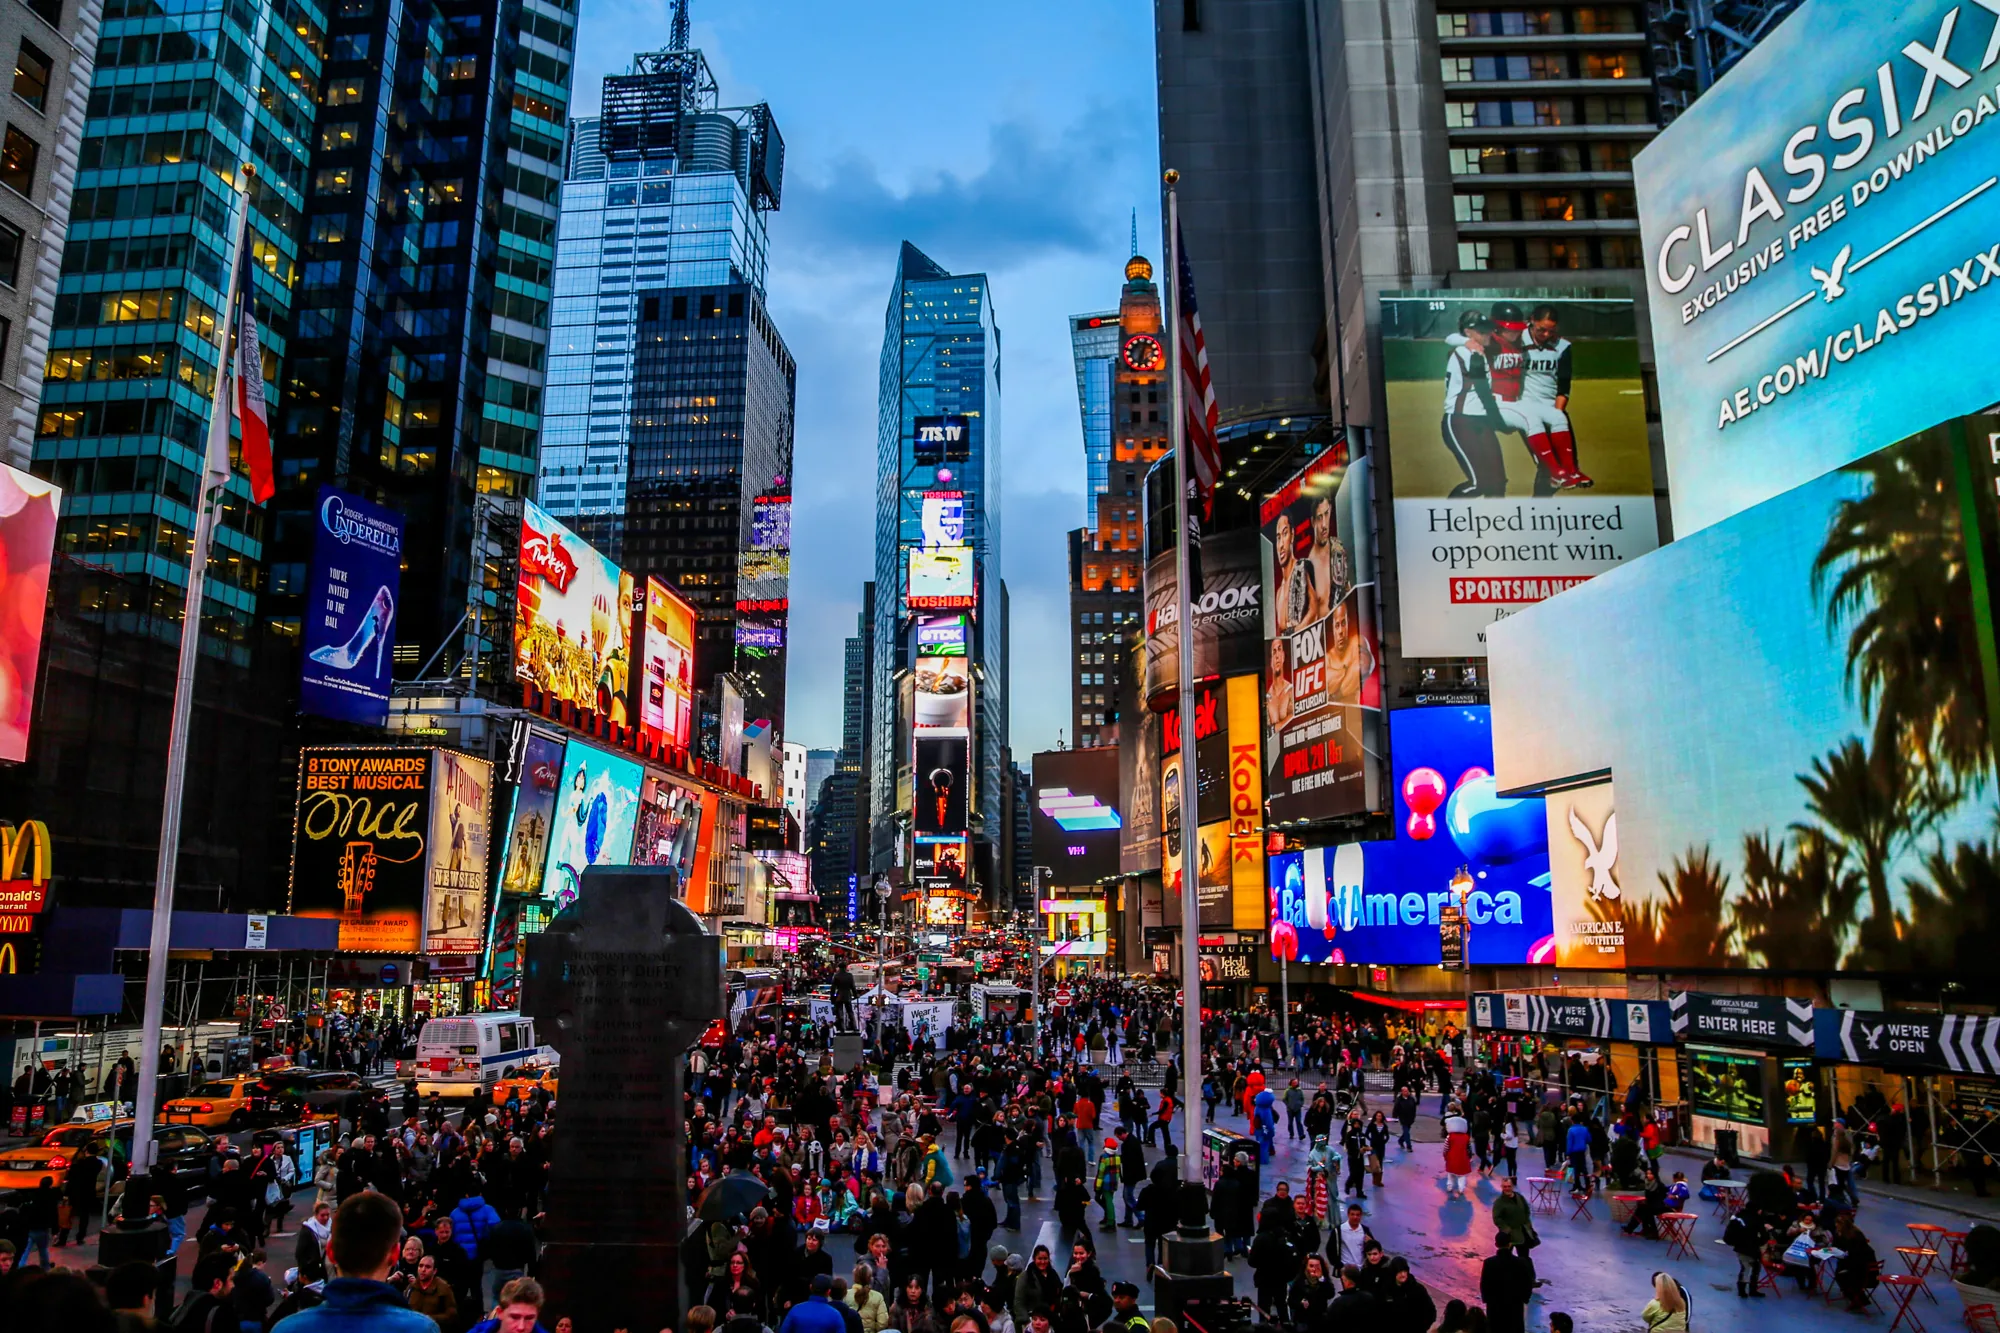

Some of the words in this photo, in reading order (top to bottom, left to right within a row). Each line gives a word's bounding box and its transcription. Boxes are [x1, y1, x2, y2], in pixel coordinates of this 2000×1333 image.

[1682, 239, 1784, 326] EXCLUSIVE
[1789, 194, 1846, 252] FREE
[1429, 301, 1446, 311] 215
[1493, 353, 1520, 370] WEST
[923, 491, 963, 499] TOSHIBA
[321, 495, 400, 553] CINDERELLA
[1427, 506, 1524, 539] Helped
[1530, 504, 1624, 538] injured
[1431, 542, 1560, 570] opponent
[1562, 536, 1624, 562] win.
[524, 537, 567, 590] Turkey
[329, 566, 348, 583] YOU'RE
[328, 583, 350, 600] INVITED
[326, 598, 334, 612] TO
[335, 600, 345, 615] THE
[631, 603, 644, 612] LG
[911, 596, 972, 608] TOSHIBA
[325, 615, 338, 630] BALL
[1202, 607, 1260, 625] emotion
[931, 629, 962, 641] TDK
[1292, 624, 1325, 669] FOX
[1295, 661, 1324, 698] UFC
[1294, 690, 1327, 715] SATURDAY
[308, 757, 319, 773] 8
[319, 757, 363, 773] TONY
[361, 757, 426, 773] AWARDS
[1283, 747, 1311, 779] APRIL
[1311, 742, 1325, 771] 20
[306, 775, 350, 790] BEST
[353, 775, 425, 790] MUSICAL
[1321, 768, 1335, 787] FOX
[1231, 743, 1260, 864] Kodak
[434, 867, 481, 891] NEWSIES
[353, 926, 380, 934] THEATER
[384, 926, 405, 935] ALBUM
[383, 919, 409, 927] AWARD
[1569, 921, 1614, 934] AMERICAN
[635, 963, 682, 977] DUFFY
[1221, 955, 1247, 970] Jekyll
[1224, 966, 1251, 980] Hyde
[814, 1005, 830, 1015] Long
[911, 1008, 931, 1018] Wear
[932, 1005, 940, 1014] it.
[1564, 1005, 1587, 1017] WE'RE
[1711, 999, 1740, 1008] AMERICAN
[1740, 1000, 1760, 1009] EAGLE
[1565, 1016, 1585, 1028] OPEN
[1698, 1015, 1738, 1032] ENTER
[1741, 1018, 1777, 1036] HERE
[1887, 1023, 1930, 1038] WE'RE
[1889, 1039, 1926, 1054] OPEN
